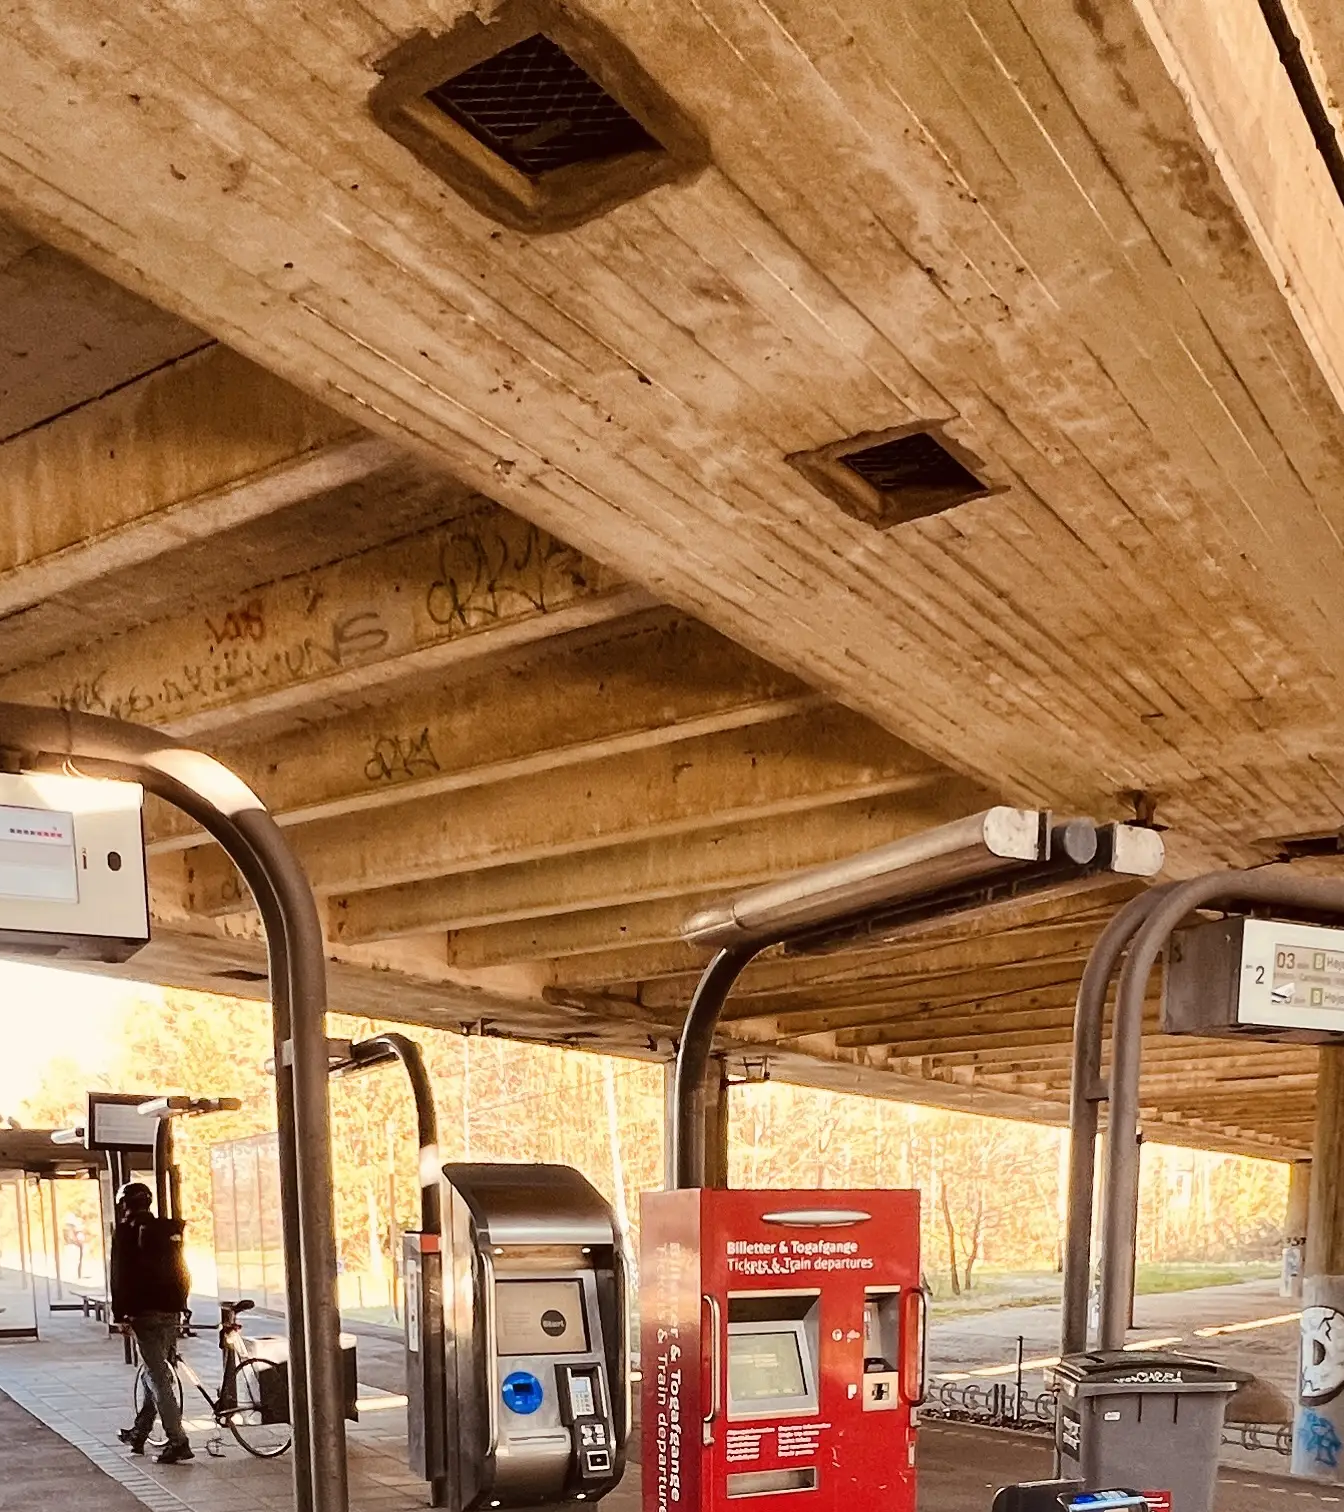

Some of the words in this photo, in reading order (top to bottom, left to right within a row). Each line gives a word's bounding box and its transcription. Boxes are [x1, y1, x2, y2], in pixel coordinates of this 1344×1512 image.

[1277, 951, 1296, 969] 03
[1255, 965, 1265, 985] 2
[727, 1241, 776, 1255] Billetter
[778, 1241, 789, 1254] &
[790, 1240, 858, 1255] Togafgange
[727, 1258, 769, 1272] Tickets
[771, 1258, 781, 1271] &
[783, 1257, 812, 1271] Train
[813, 1257, 874, 1272] departures
[657, 1328, 668, 1344] &
[669, 1344, 682, 1363] &
[657, 1353, 669, 1406] Train
[669, 1368, 682, 1503] Togafgange
